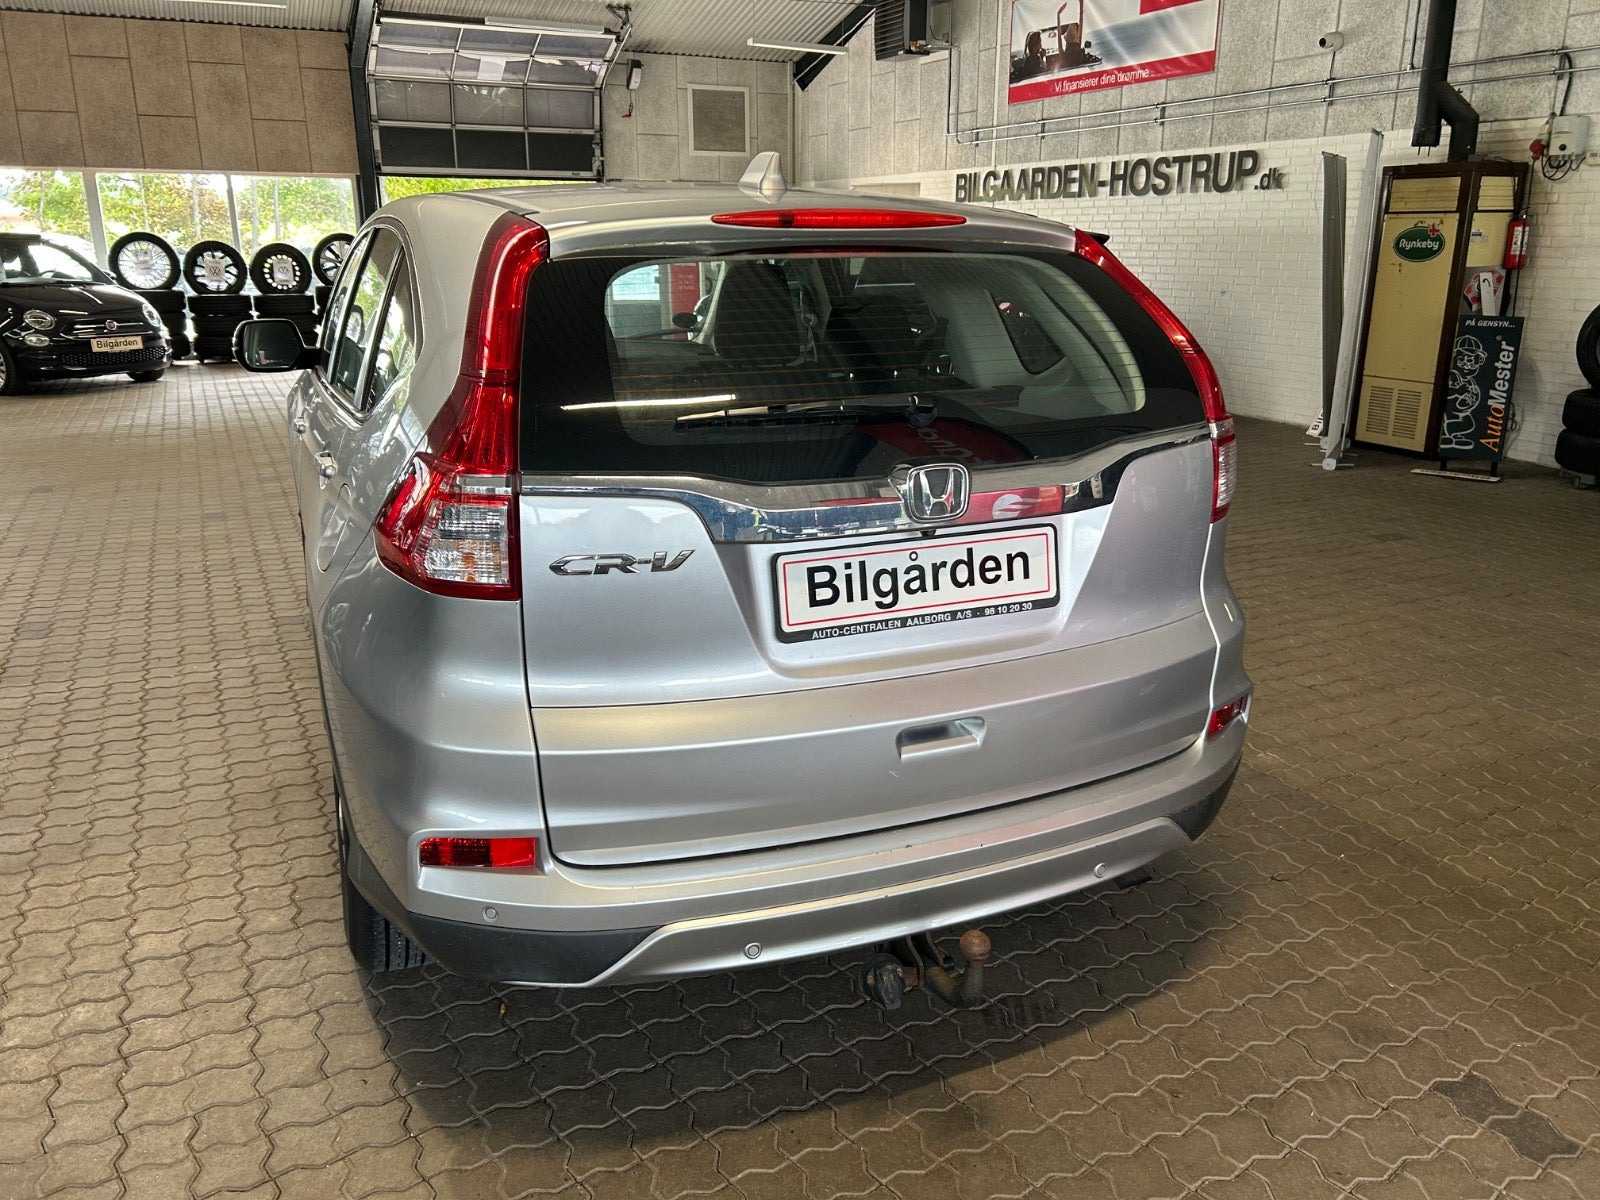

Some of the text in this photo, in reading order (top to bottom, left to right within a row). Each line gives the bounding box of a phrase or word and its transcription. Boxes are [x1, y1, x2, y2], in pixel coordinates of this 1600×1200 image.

[1054, 68, 1150, 92] Vi finansierer dine drømme
[1400, 238, 1440, 251] Rynkeby
[1465, 318, 1476, 326] PÅ
[96, 339, 138, 350] Bilgården
[549, 549, 696, 576] CR-V
[806, 547, 1030, 610] Bilgården
[811, 602, 1033, 640] AUTO-CENTRALEN AALBORG A/S 98 10 20 30
